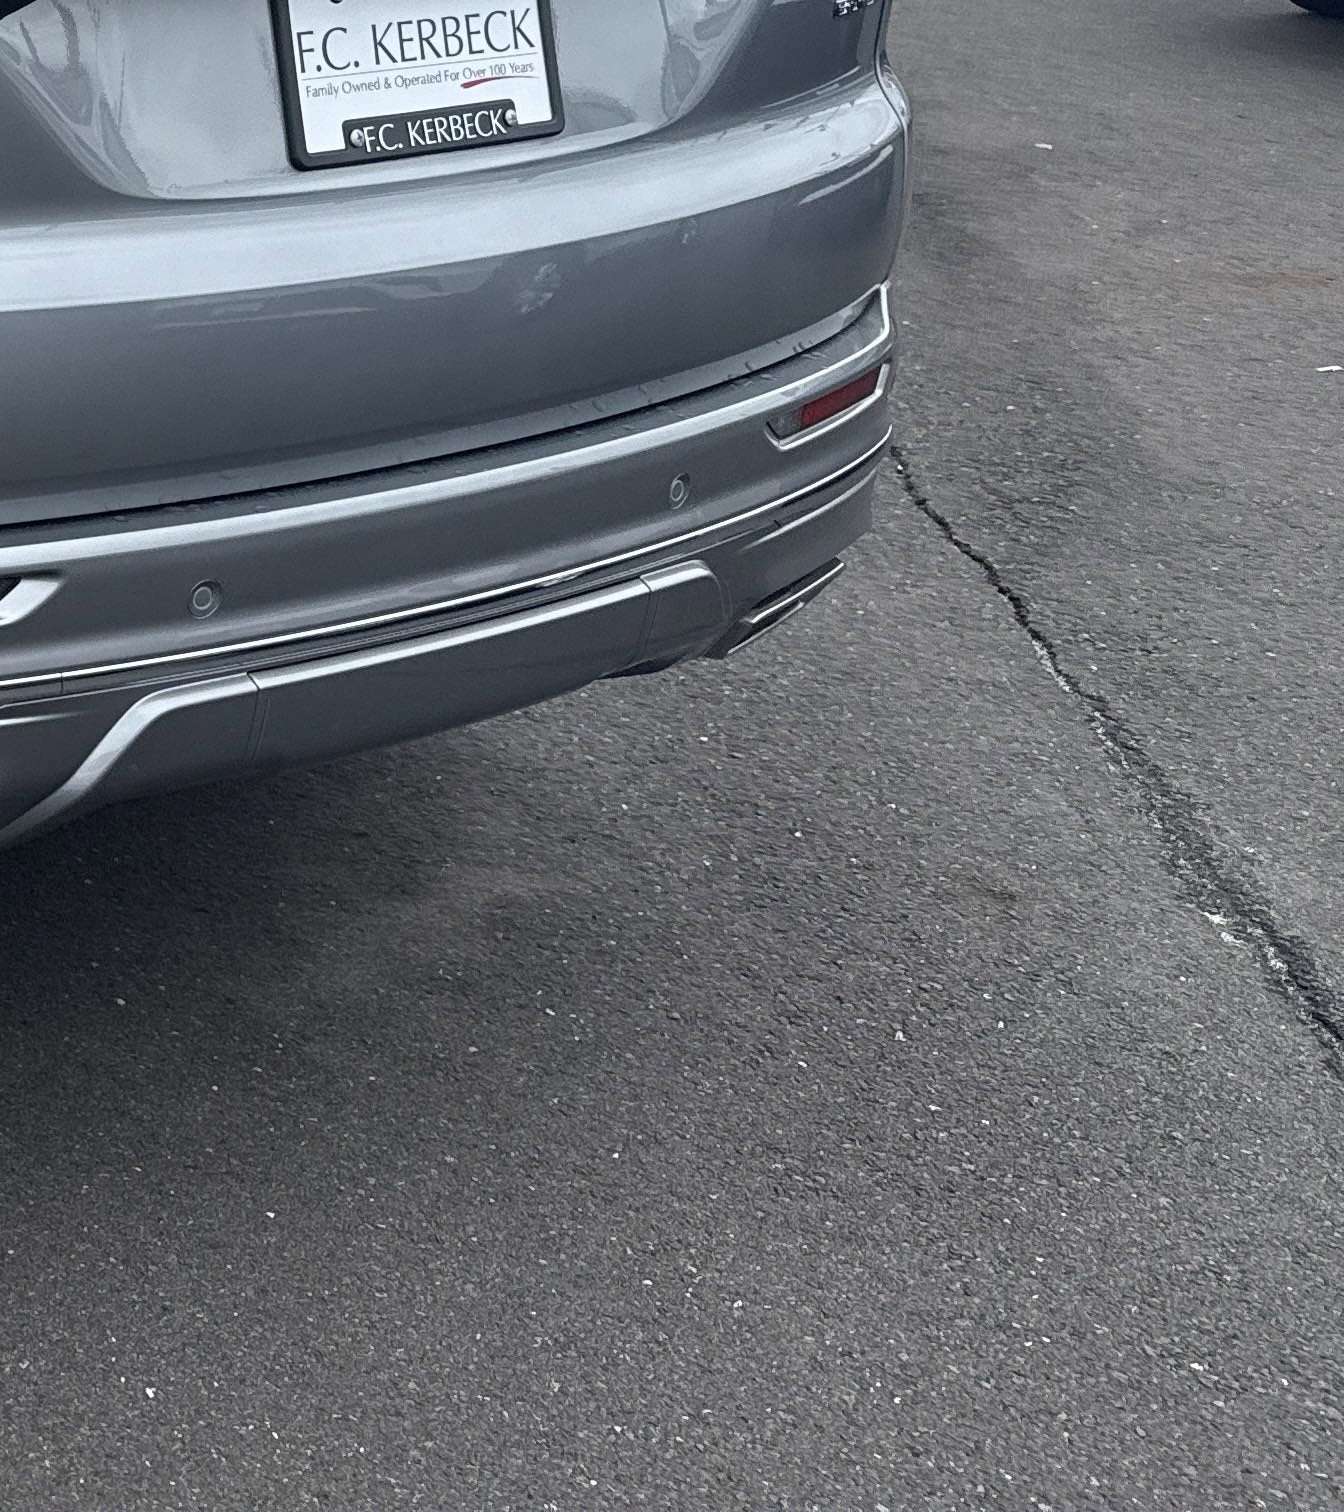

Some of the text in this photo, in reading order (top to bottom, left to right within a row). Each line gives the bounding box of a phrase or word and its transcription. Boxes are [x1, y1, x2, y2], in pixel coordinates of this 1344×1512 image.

[296, 8, 535, 74] F.C. KERBECK
[305, 61, 534, 98] Family Owned & Operated For Over 100 Years
[363, 109, 507, 153] F.C. KERBECK
